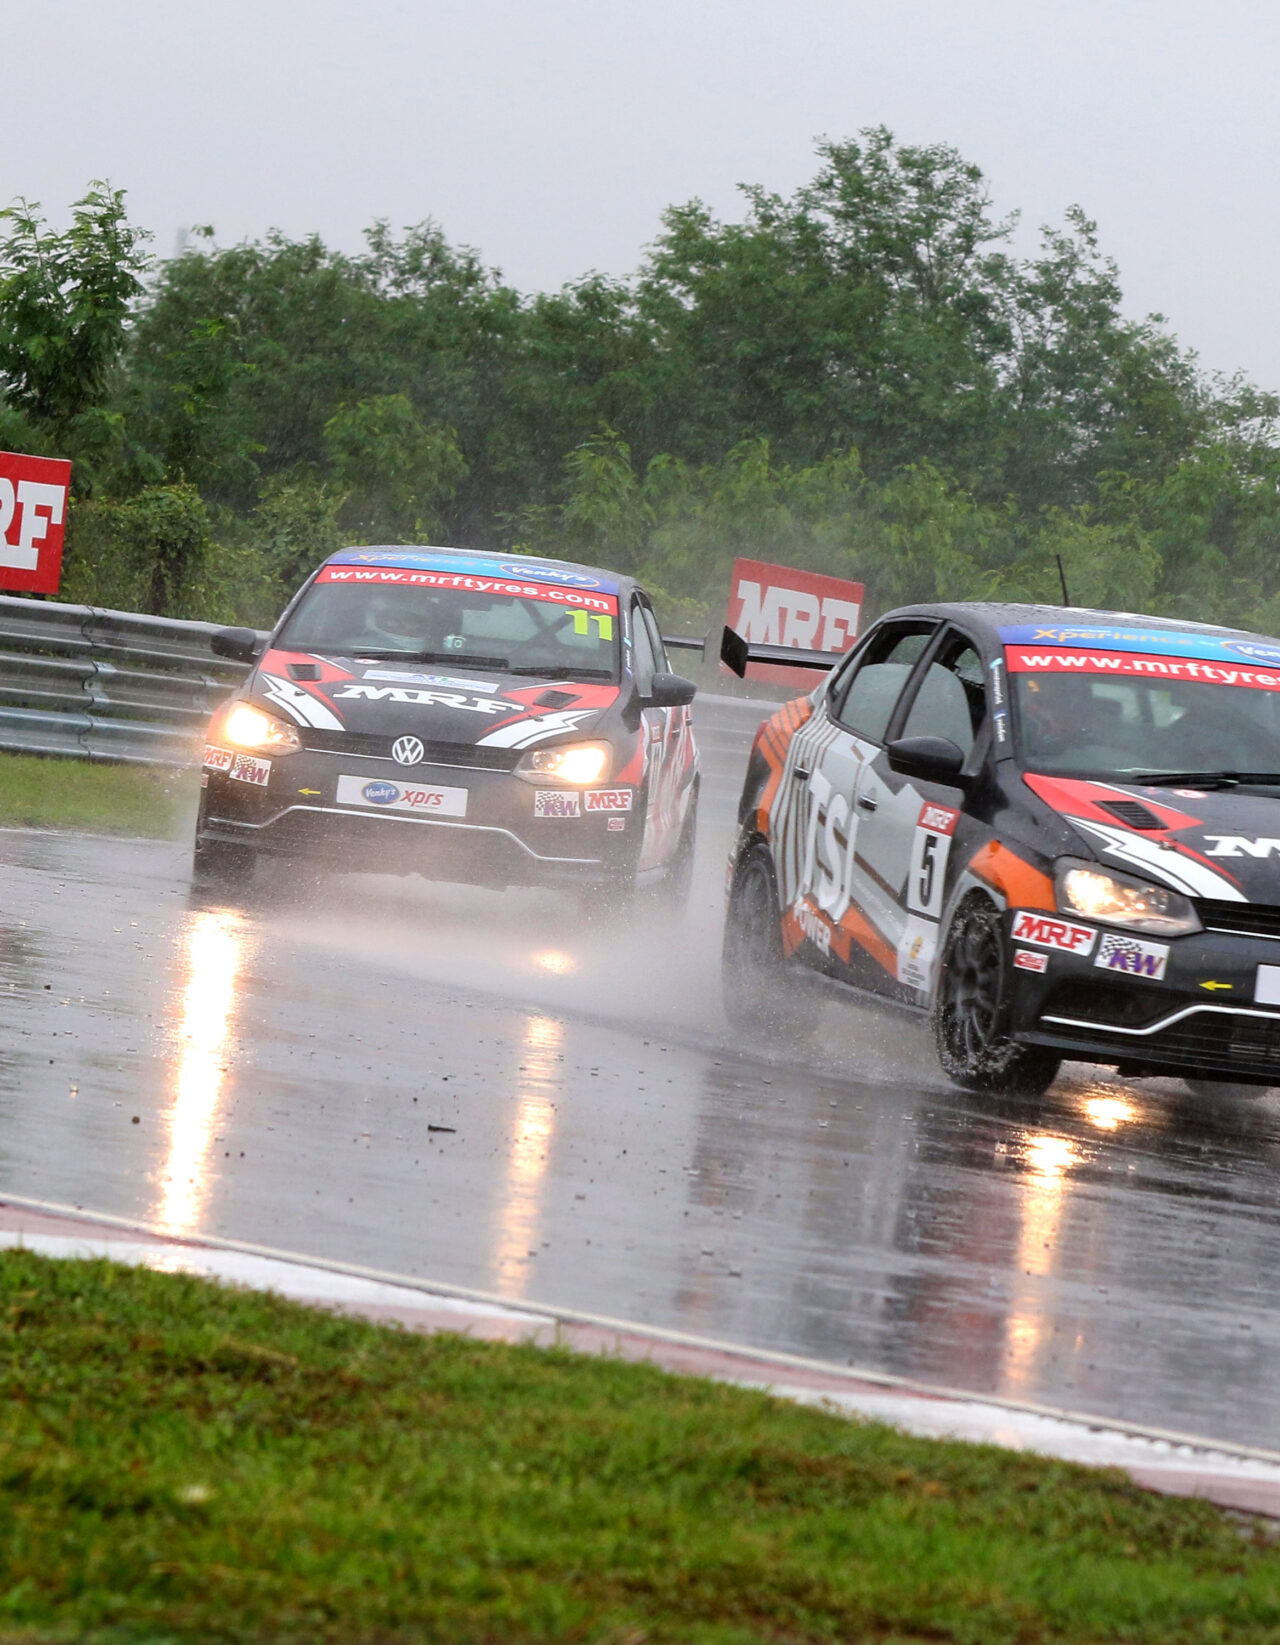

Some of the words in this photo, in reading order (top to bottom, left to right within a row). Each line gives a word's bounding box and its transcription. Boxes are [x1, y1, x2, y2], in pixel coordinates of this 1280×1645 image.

[330, 569, 610, 610] www.mrftyres.com
[565, 609, 613, 641] 11
[735, 579, 860, 652] MRF
[333, 684, 525, 715] MRF
[204, 745, 230, 767] MRF
[365, 786, 397, 799] Venky's
[400, 788, 444, 807] xprs
[587, 791, 631, 809] MRF
[919, 834, 938, 907] 5
[1015, 915, 1093, 949] MRF
[1109, 949, 1165, 976] KW
